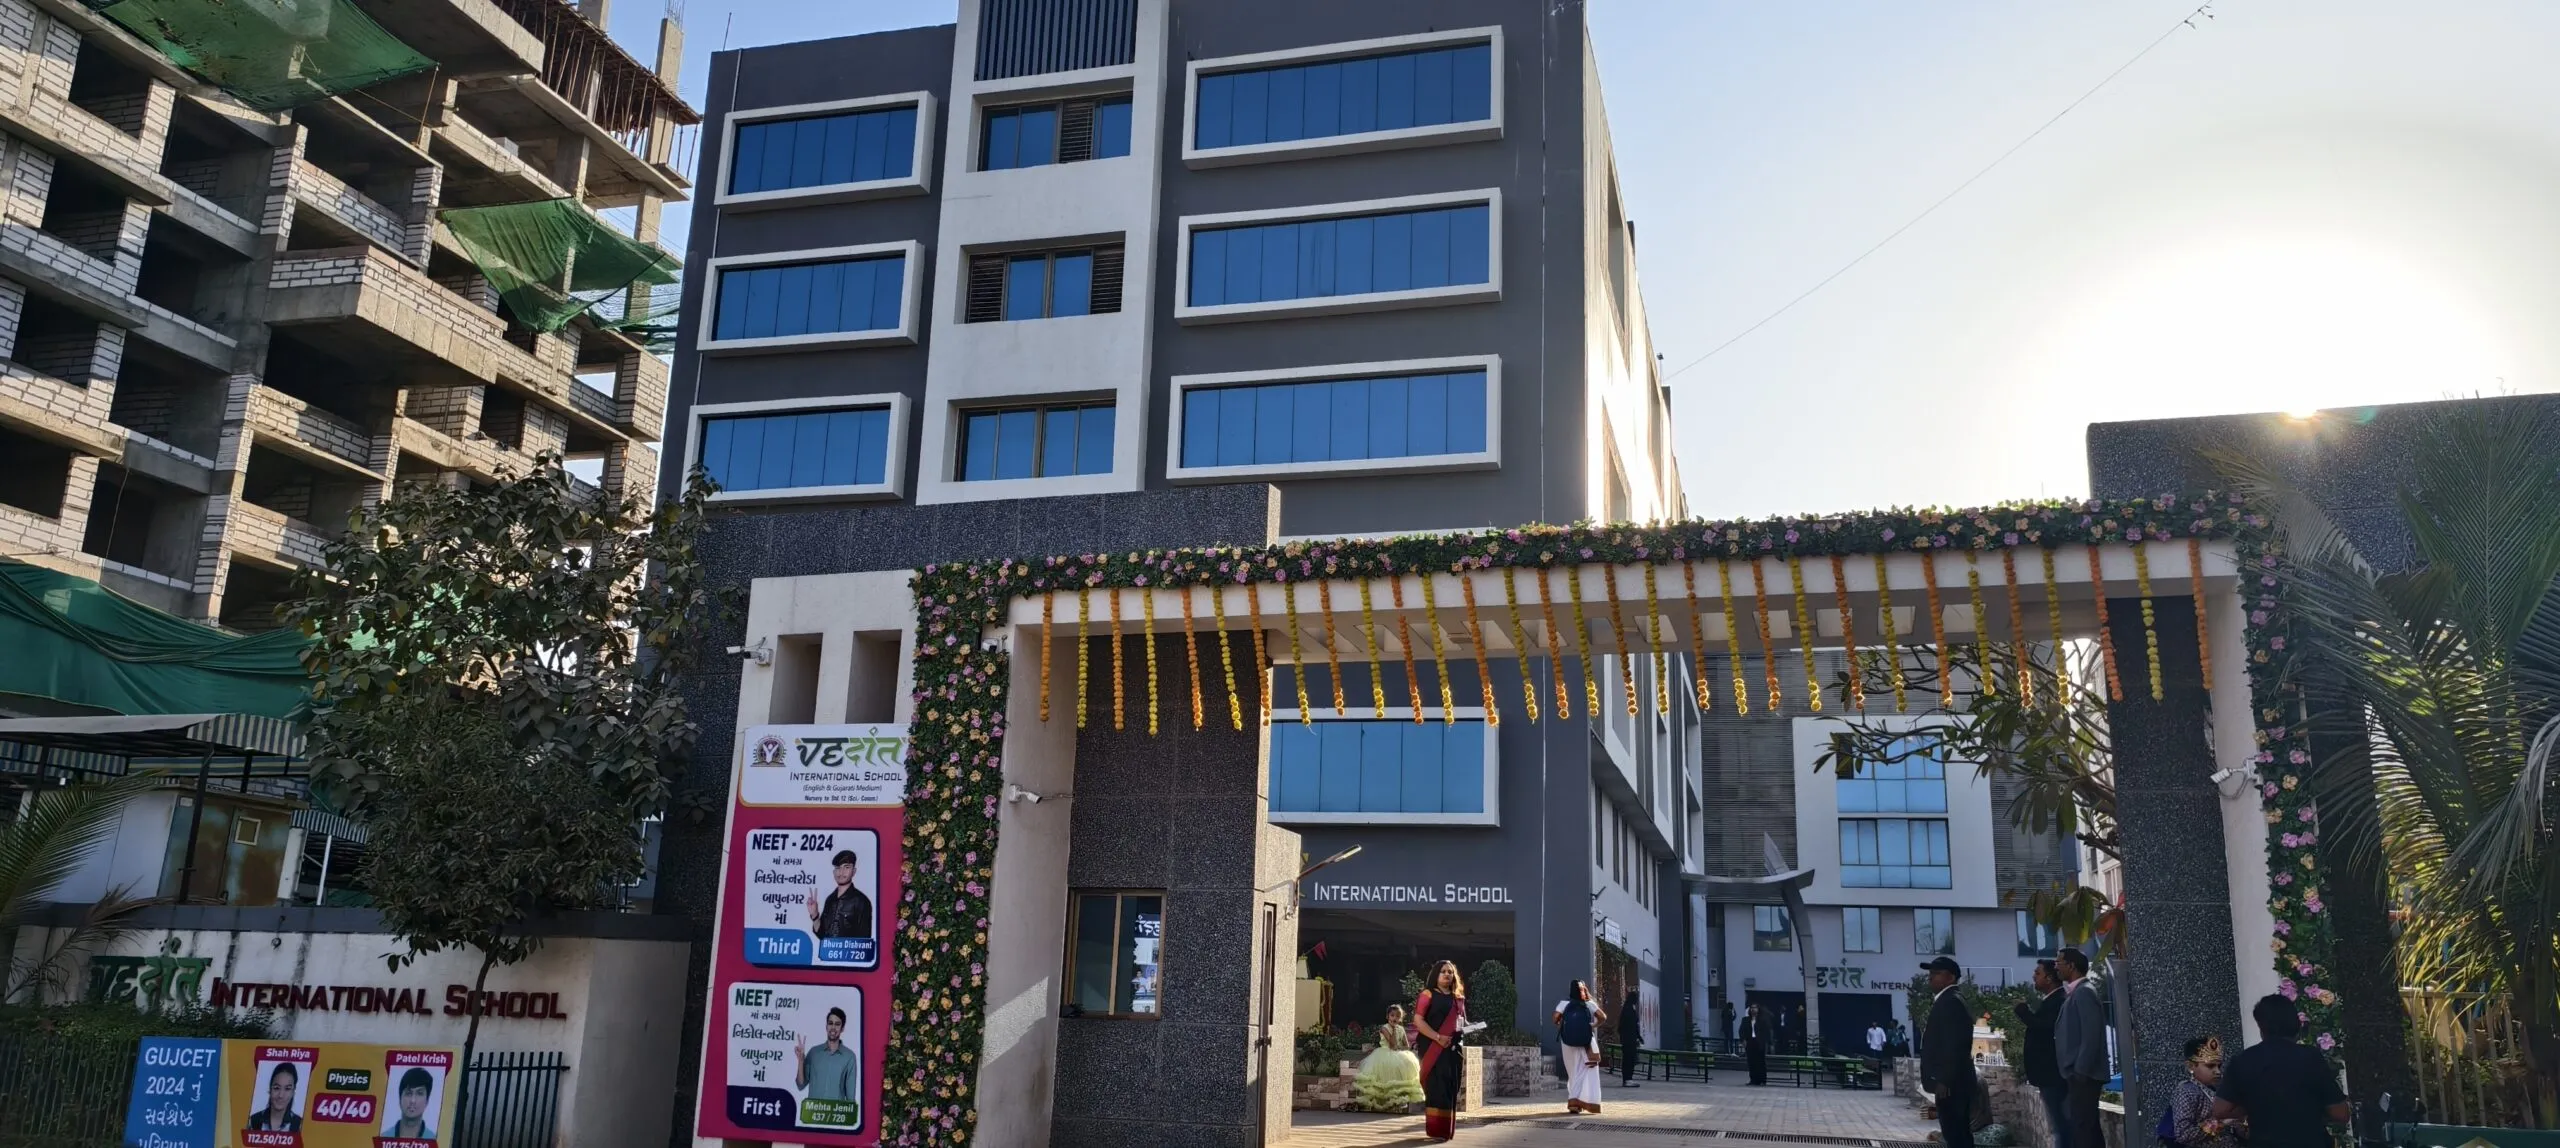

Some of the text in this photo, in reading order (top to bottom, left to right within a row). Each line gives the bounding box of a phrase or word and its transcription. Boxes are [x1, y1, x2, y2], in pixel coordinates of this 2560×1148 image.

[789, 771, 903, 781] INTERNATIONAL SCHOOL
[802, 785, 825, 793] (English
[832, 785, 855, 793] Gujarati
[752, 833, 789, 850] NEET
[800, 834, 834, 851] 2024
[772, 856, 781, 865] માં
[754, 869, 816, 884] નિકોલ-નરોડા
[1314, 882, 1513, 903] INTERNATIONAL SCHOOL
[762, 893, 805, 909] બાપુનગર
[775, 909, 787, 924] માં
[758, 937, 800, 955] Third
[828, 951, 842, 959] 661
[850, 951, 866, 960] 720
[211, 977, 568, 1020] INTERNATIONAL SCHOOL
[735, 988, 799, 1010] NEET (2021)
[750, 1010, 759, 1019] માં
[732, 1023, 795, 1041] નિકોલ-નરોડા
[145, 1047, 216, 1067] GUJCET
[266, 1048, 311, 1060] Shah Riya
[395, 1053, 447, 1064] Patel Krish
[740, 1048, 783, 1065] બાપુનગર
[328, 1073, 368, 1085] Physics
[753, 1066, 766, 1082] માં
[145, 1074, 204, 1102] 2024 નું
[145, 1101, 194, 1127] સર્વશ્રેષ્ઠ
[316, 1095, 371, 1119] 40/40
[742, 1097, 781, 1116] First
[805, 1101, 854, 1112] Mehta Jenil
[832, 1113, 846, 1122] 720
[247, 1134, 294, 1146] 112.50/120
